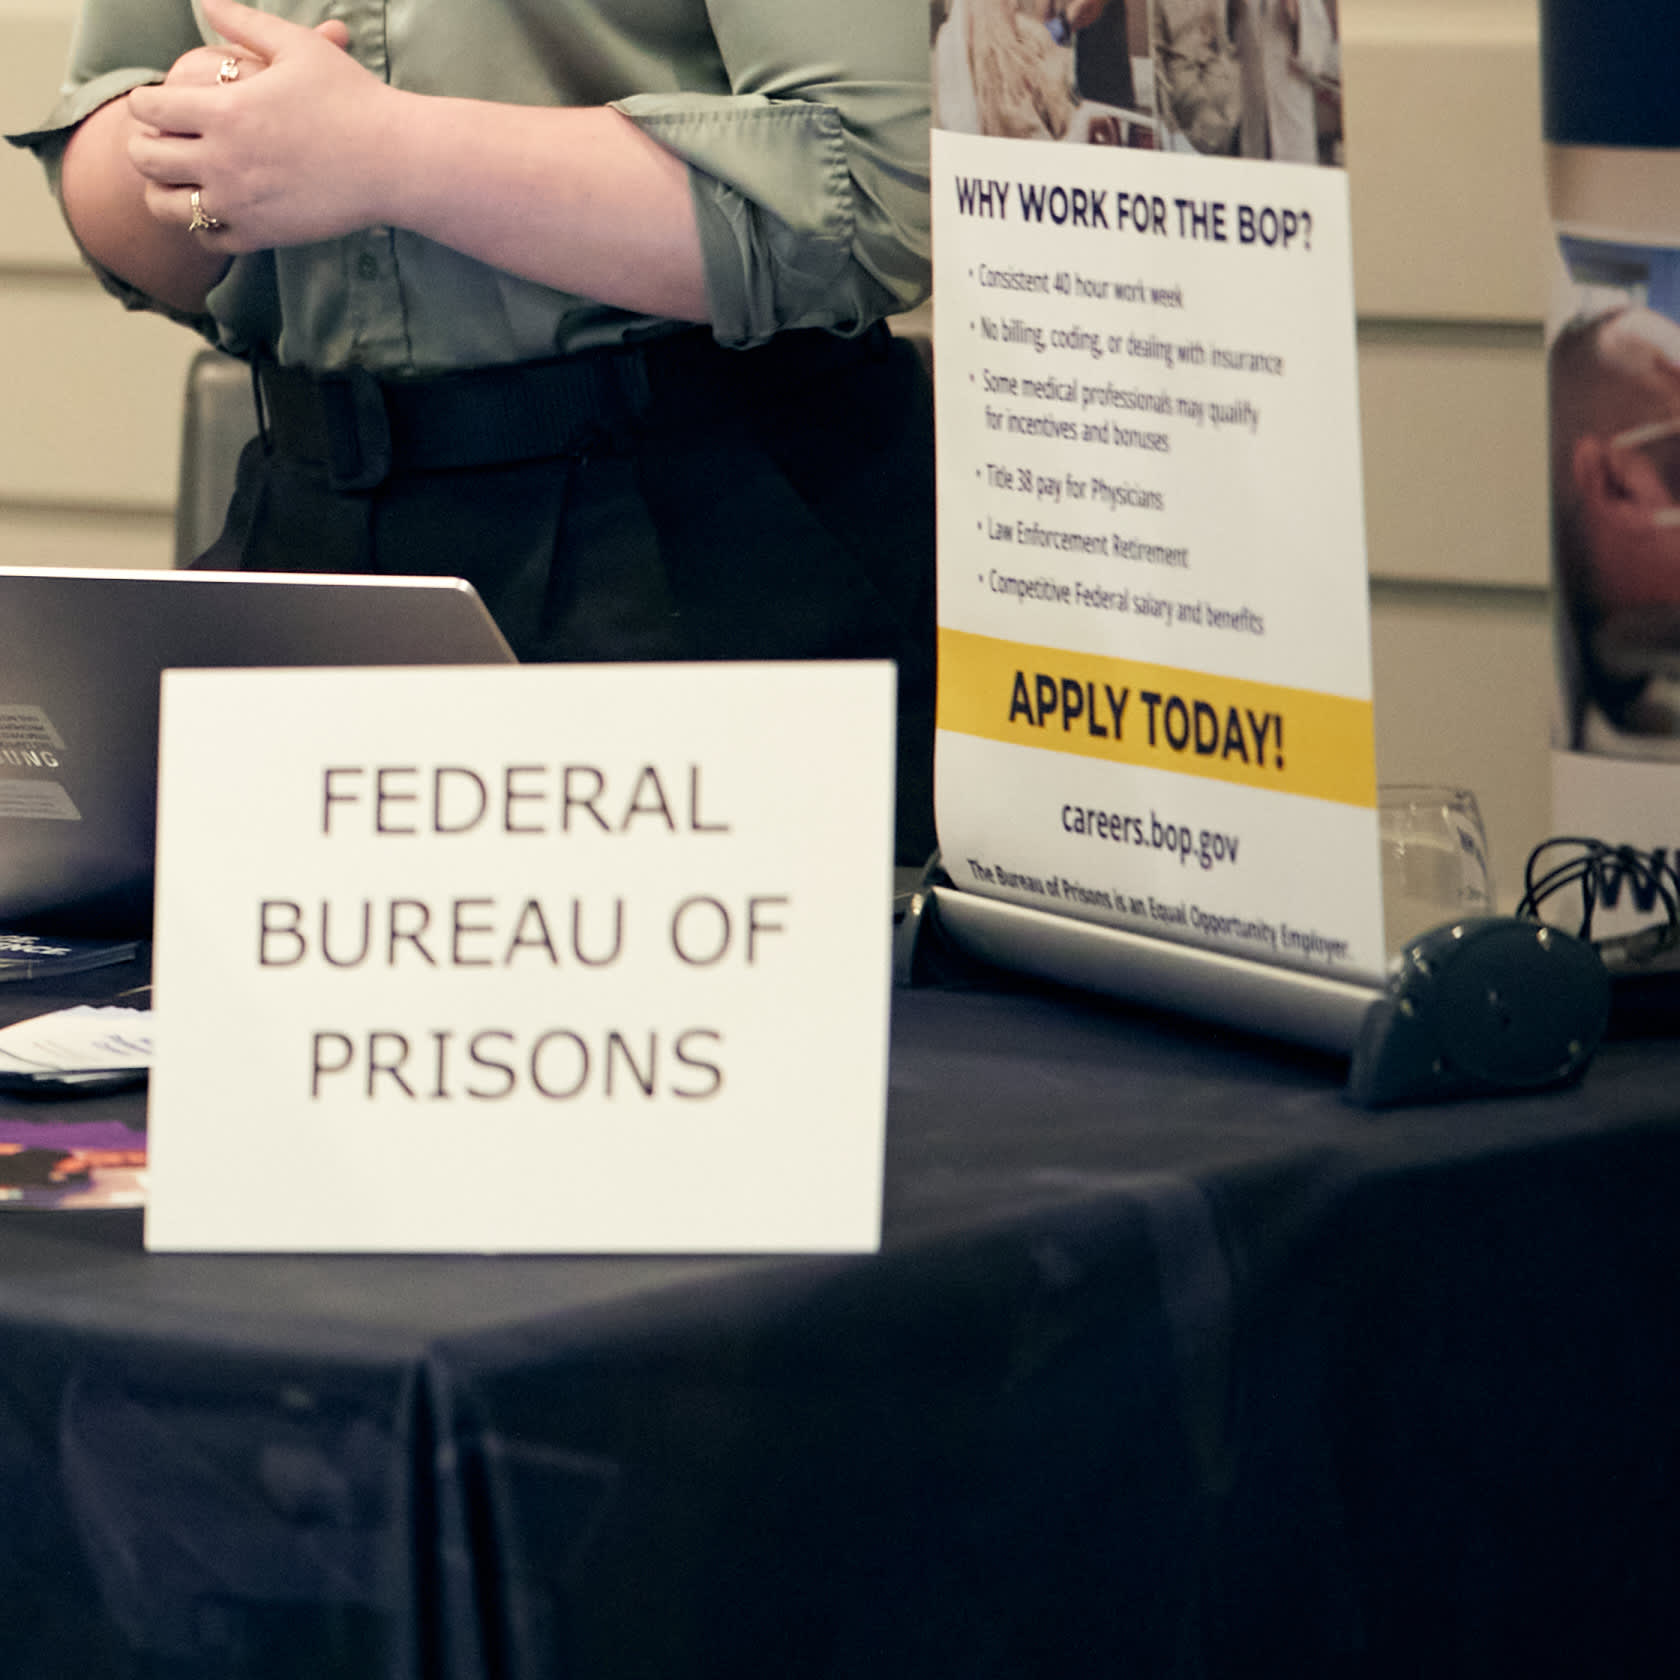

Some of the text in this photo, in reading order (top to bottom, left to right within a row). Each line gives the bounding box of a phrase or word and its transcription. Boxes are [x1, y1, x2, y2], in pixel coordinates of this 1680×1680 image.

[955, 175, 1313, 252] WHY WORK FOR THE BOP?
[978, 263, 1185, 309] Consistent 40 hour work week
[980, 316, 1284, 376] No billing, coding, or dealing with insurance
[982, 368, 1261, 436] Some medical professionals may qualify
[984, 404, 1171, 453] for incentives and bonuses
[986, 463, 1165, 512] Title 38 pay for Physicians
[987, 517, 1191, 569] Law Enforcement Retirement
[989, 569, 1266, 636] Competitive Federal salary and benefits
[1007, 670, 1286, 771] APPLY TODAY!
[319, 762, 733, 837] FEDERAL
[1060, 802, 1240, 871] careers.bop.gov
[256, 893, 792, 970] BUREAU OF
[967, 858, 995, 885] The
[996, 864, 1043, 895] Bureau
[1046, 874, 1061, 897] of
[1062, 876, 1112, 909] Prisons
[1113, 886, 1127, 913] is
[1129, 895, 1146, 917] an
[1148, 895, 1187, 930] Equal
[1190, 903, 1278, 950] Opportunity
[309, 1028, 727, 1102] PRISONS
